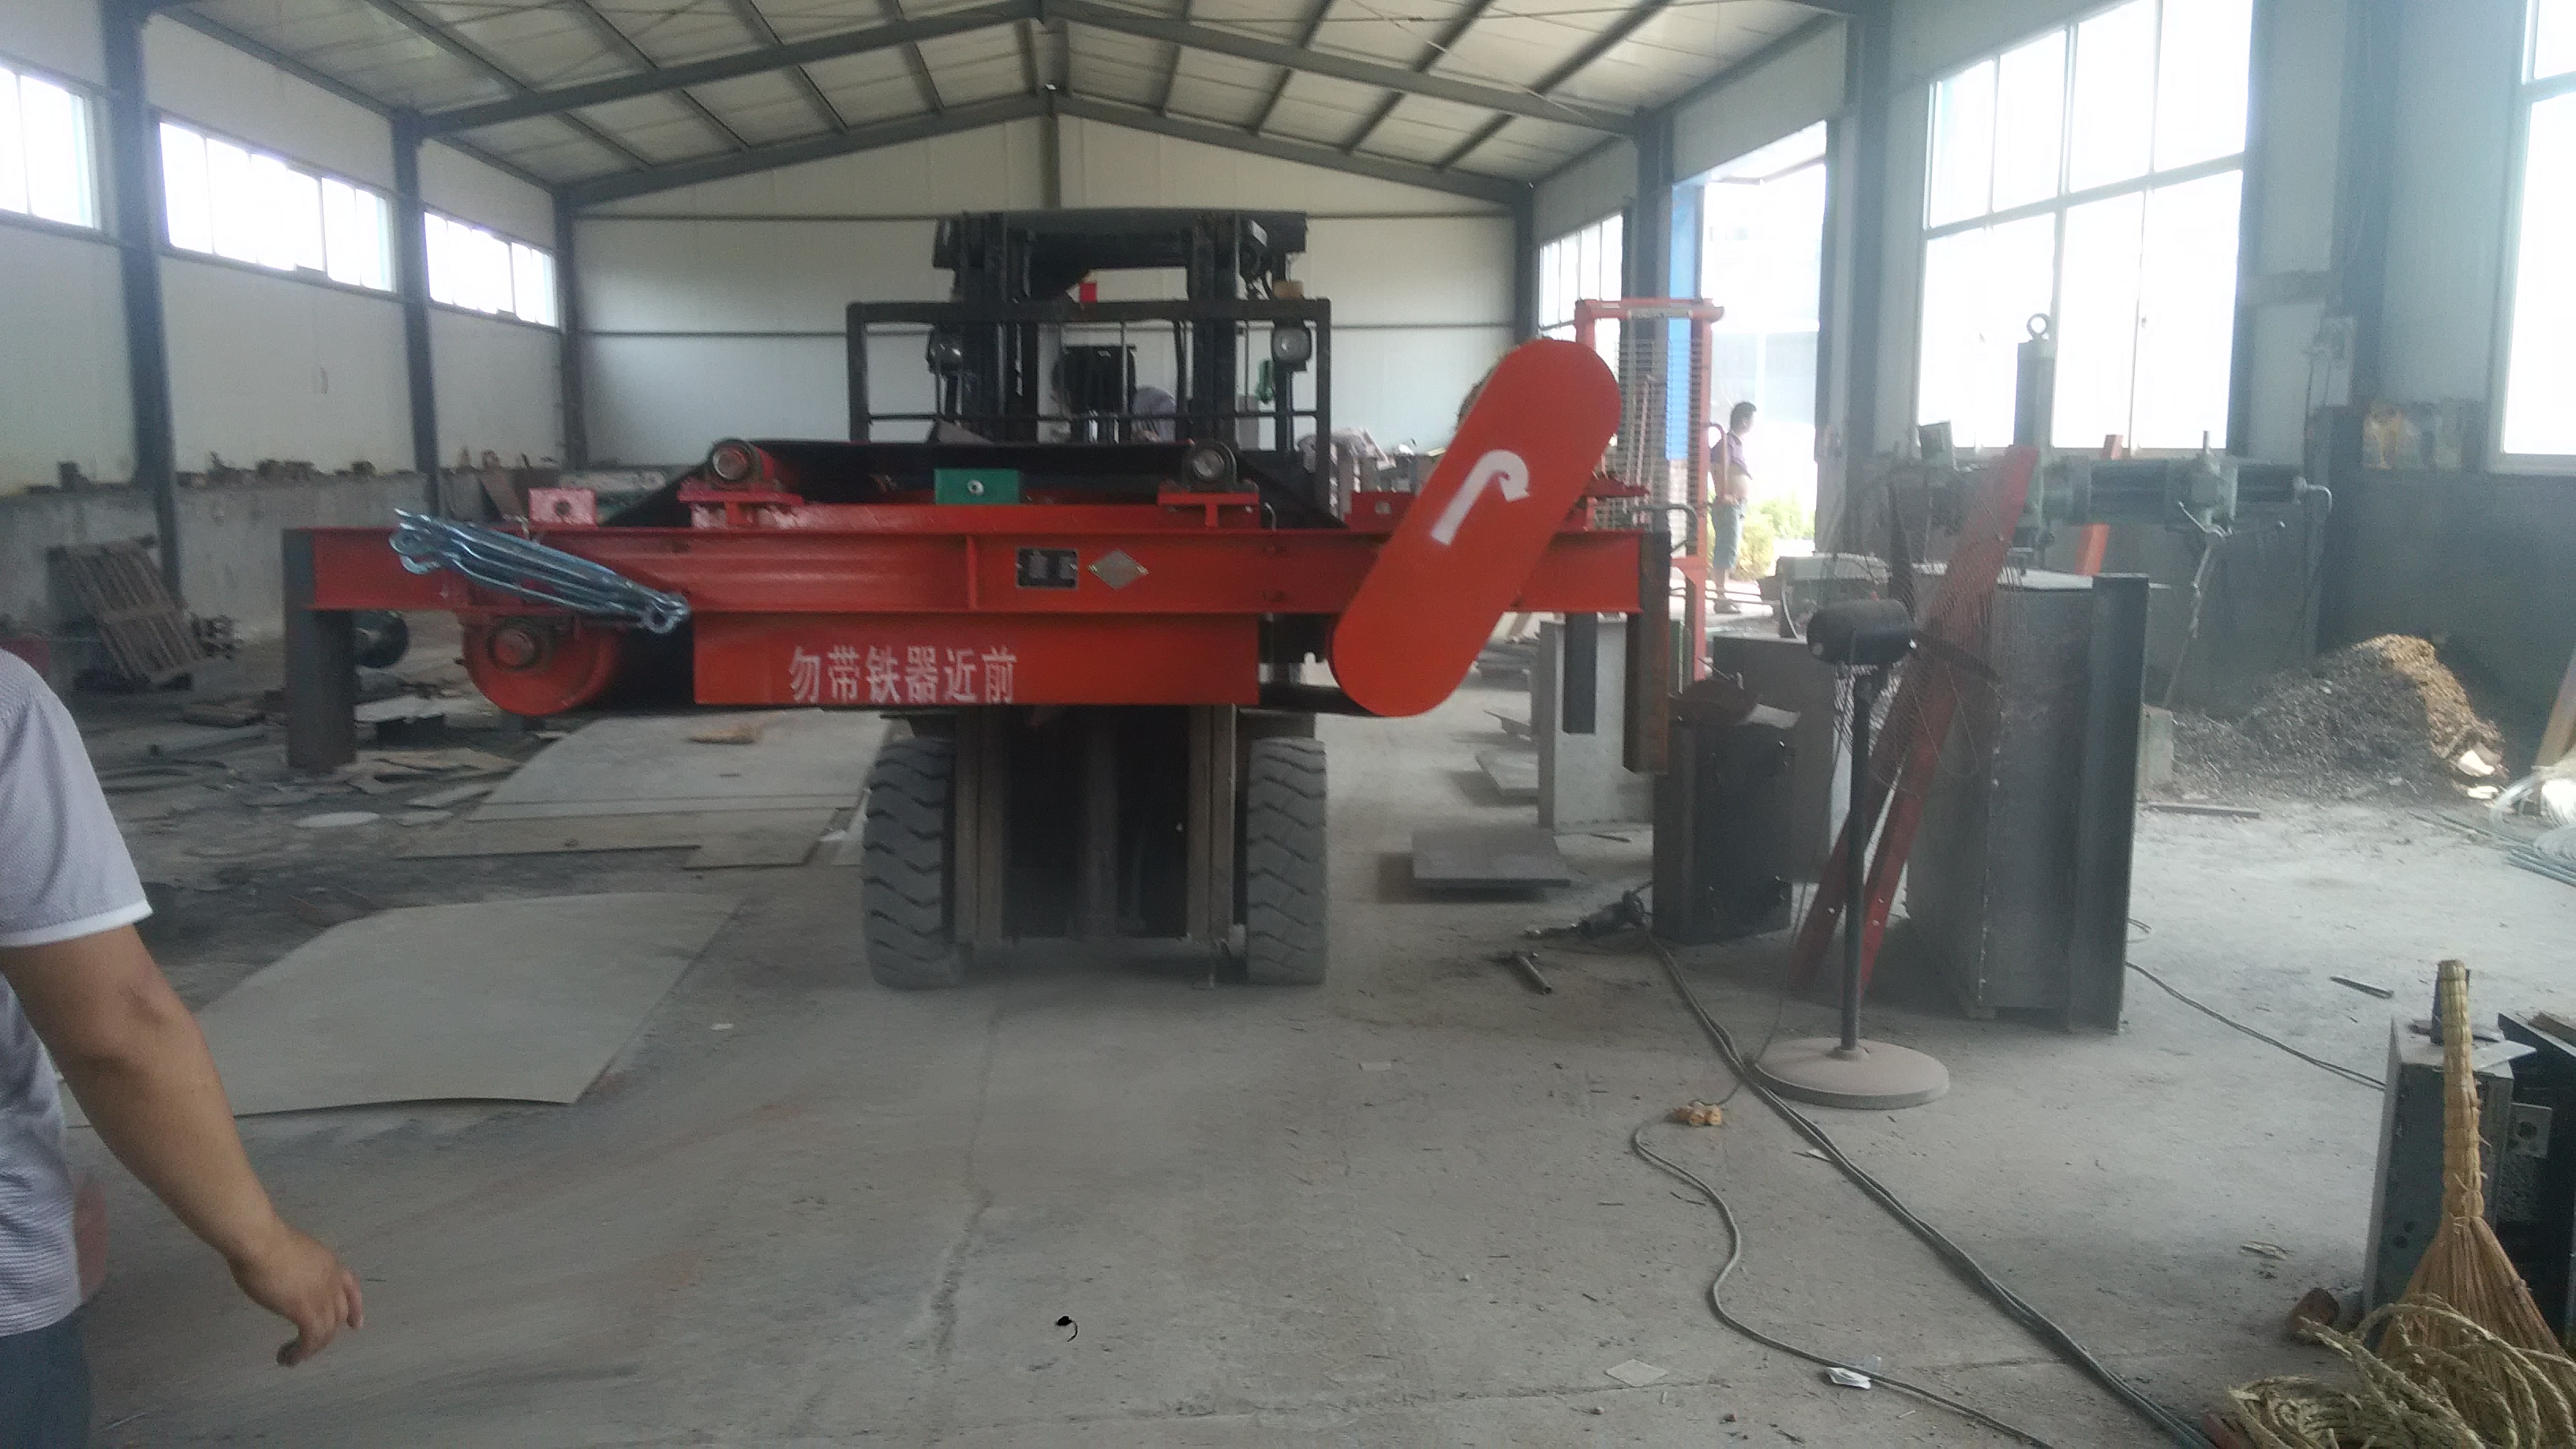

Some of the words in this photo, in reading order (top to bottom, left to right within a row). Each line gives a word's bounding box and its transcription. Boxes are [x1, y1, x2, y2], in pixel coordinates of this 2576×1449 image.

[789, 645, 1017, 704] 勿带铁器近前
